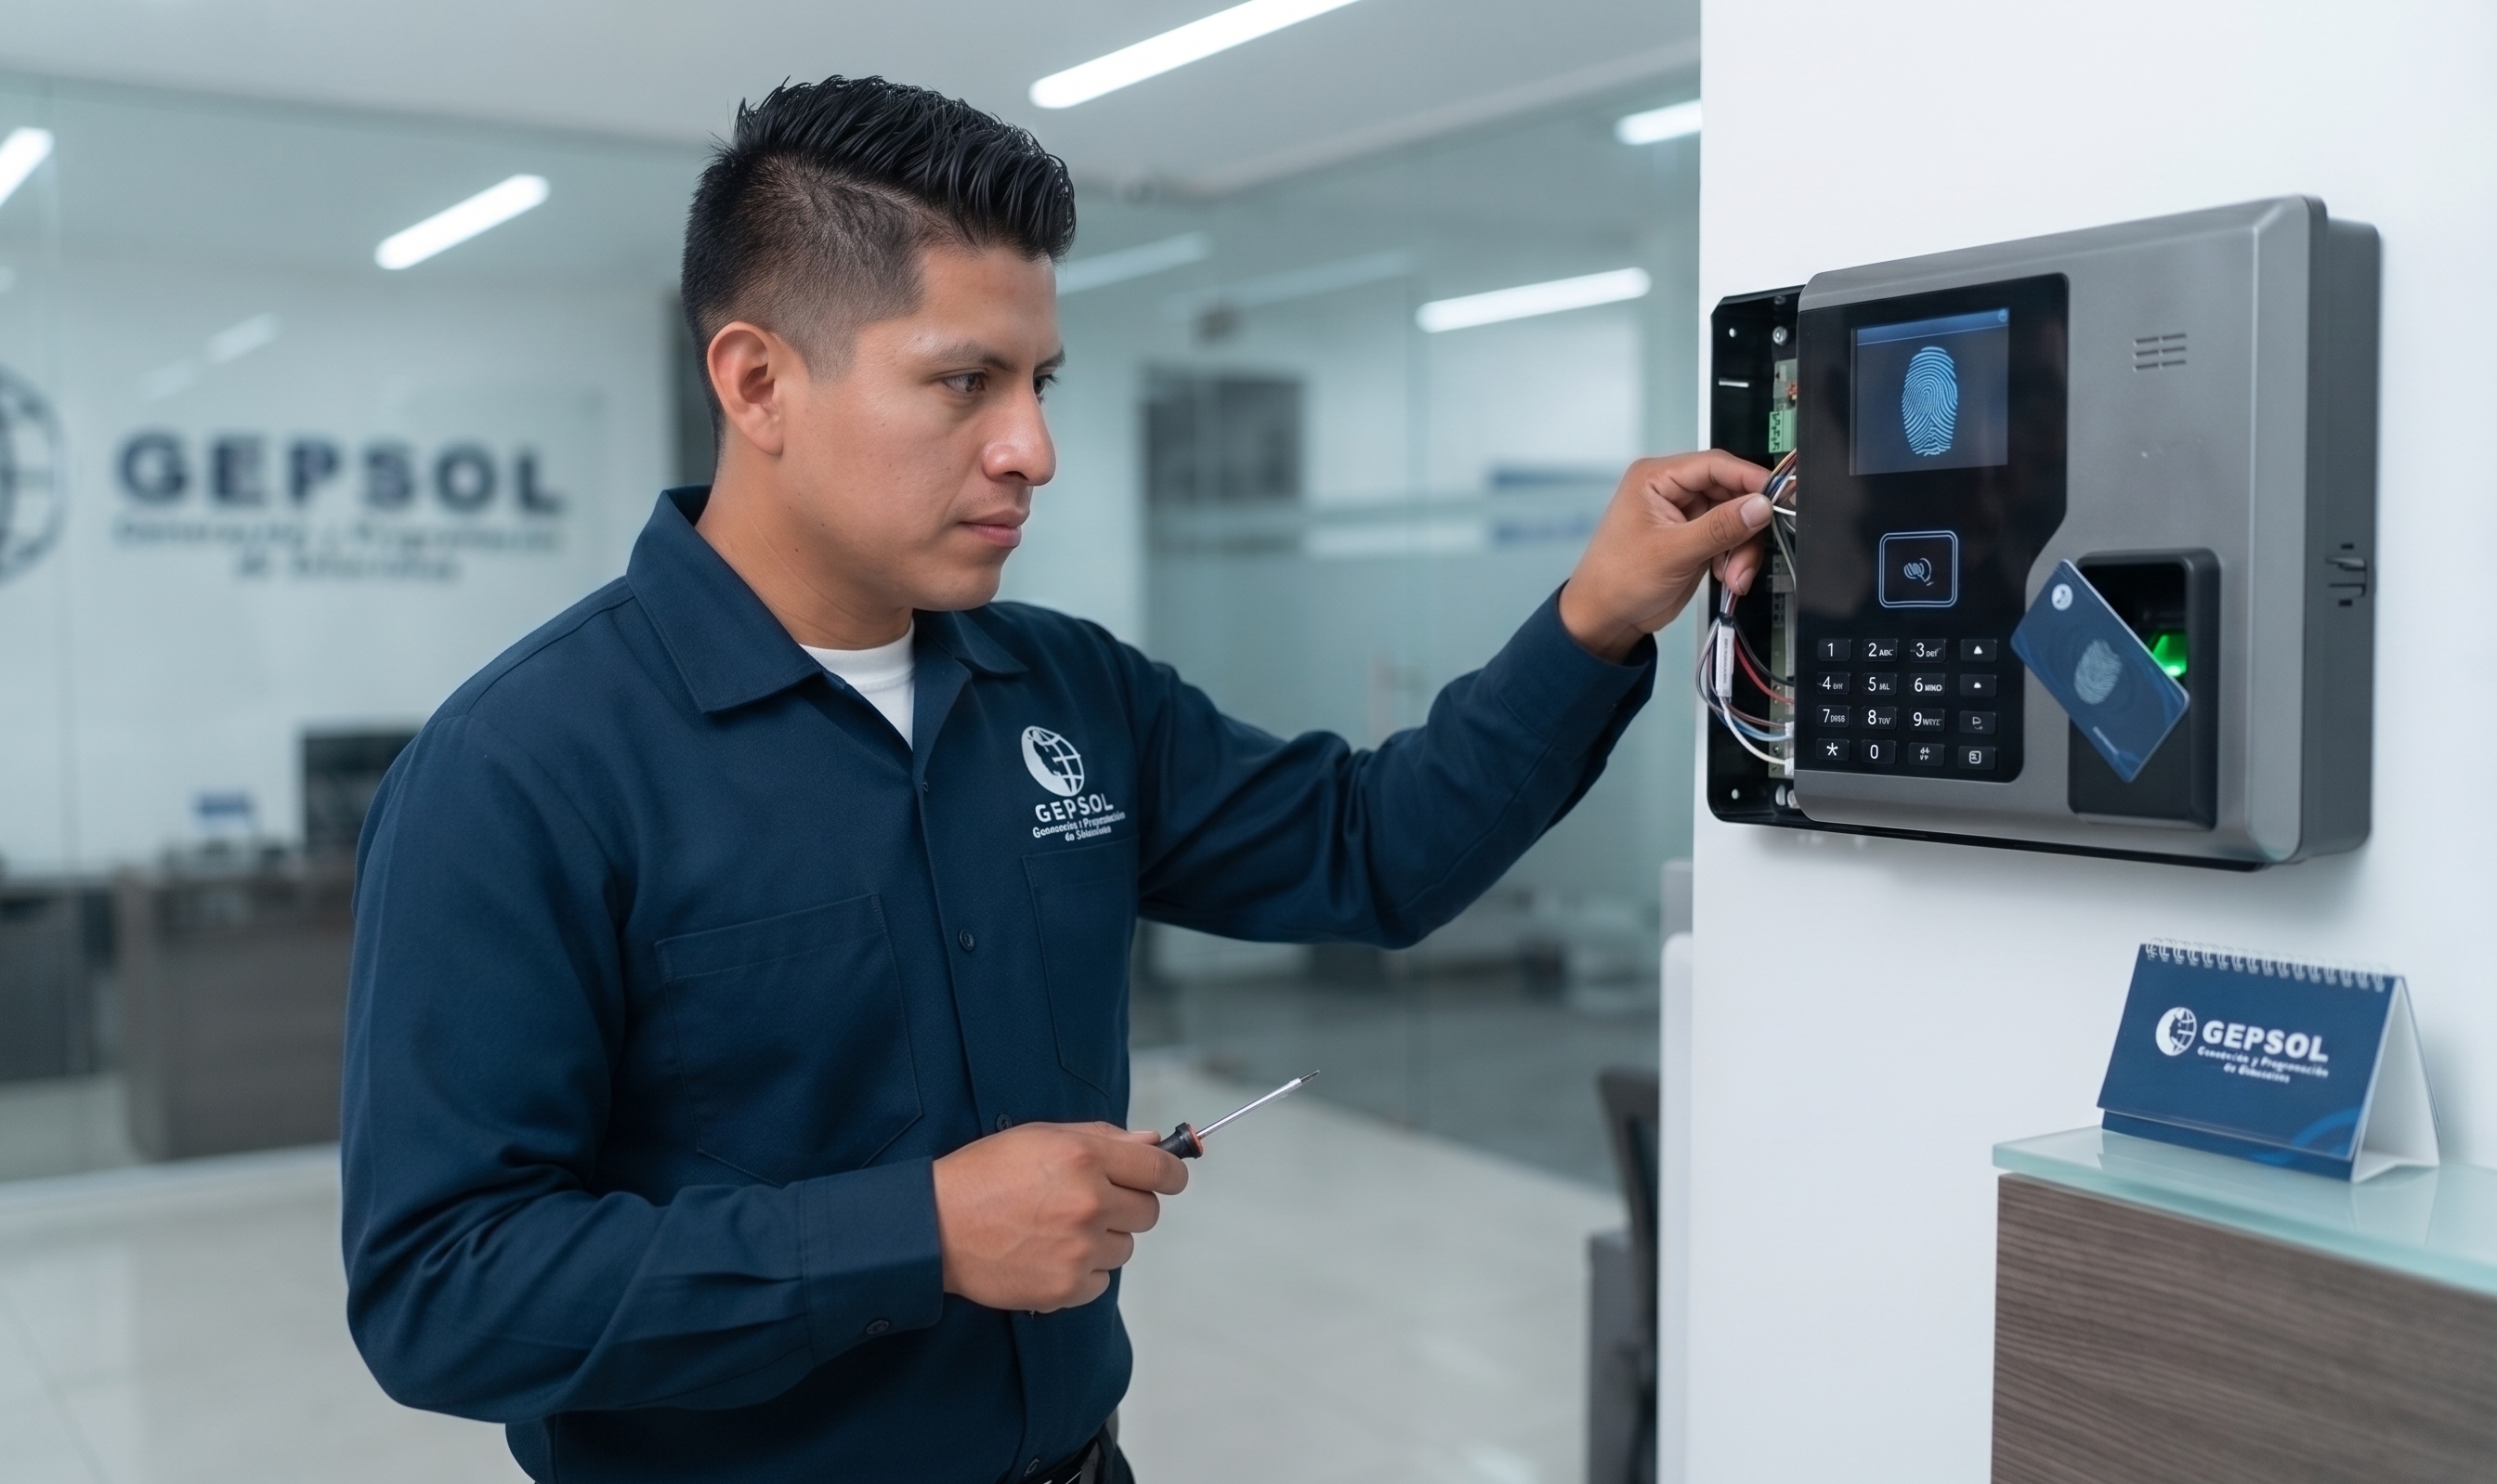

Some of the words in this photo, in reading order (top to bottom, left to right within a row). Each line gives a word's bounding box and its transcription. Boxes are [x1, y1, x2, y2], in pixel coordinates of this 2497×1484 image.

[117, 431, 566, 516] GEPSOL
[1826, 643, 1835, 657] 1
[1868, 643, 1877, 657] 2
[1915, 643, 1925, 657] 3
[1822, 676, 1832, 691] 4
[1868, 677, 1877, 692] 5
[1914, 678, 1923, 693] 6
[1823, 709, 1831, 722] 7
[1867, 709, 1877, 724] 8
[1913, 712, 1922, 727] 9
[1870, 744, 1878, 760] 0
[1035, 793, 1114, 823] GEPSOL
[2202, 1020, 2329, 1063] GEPSOL
